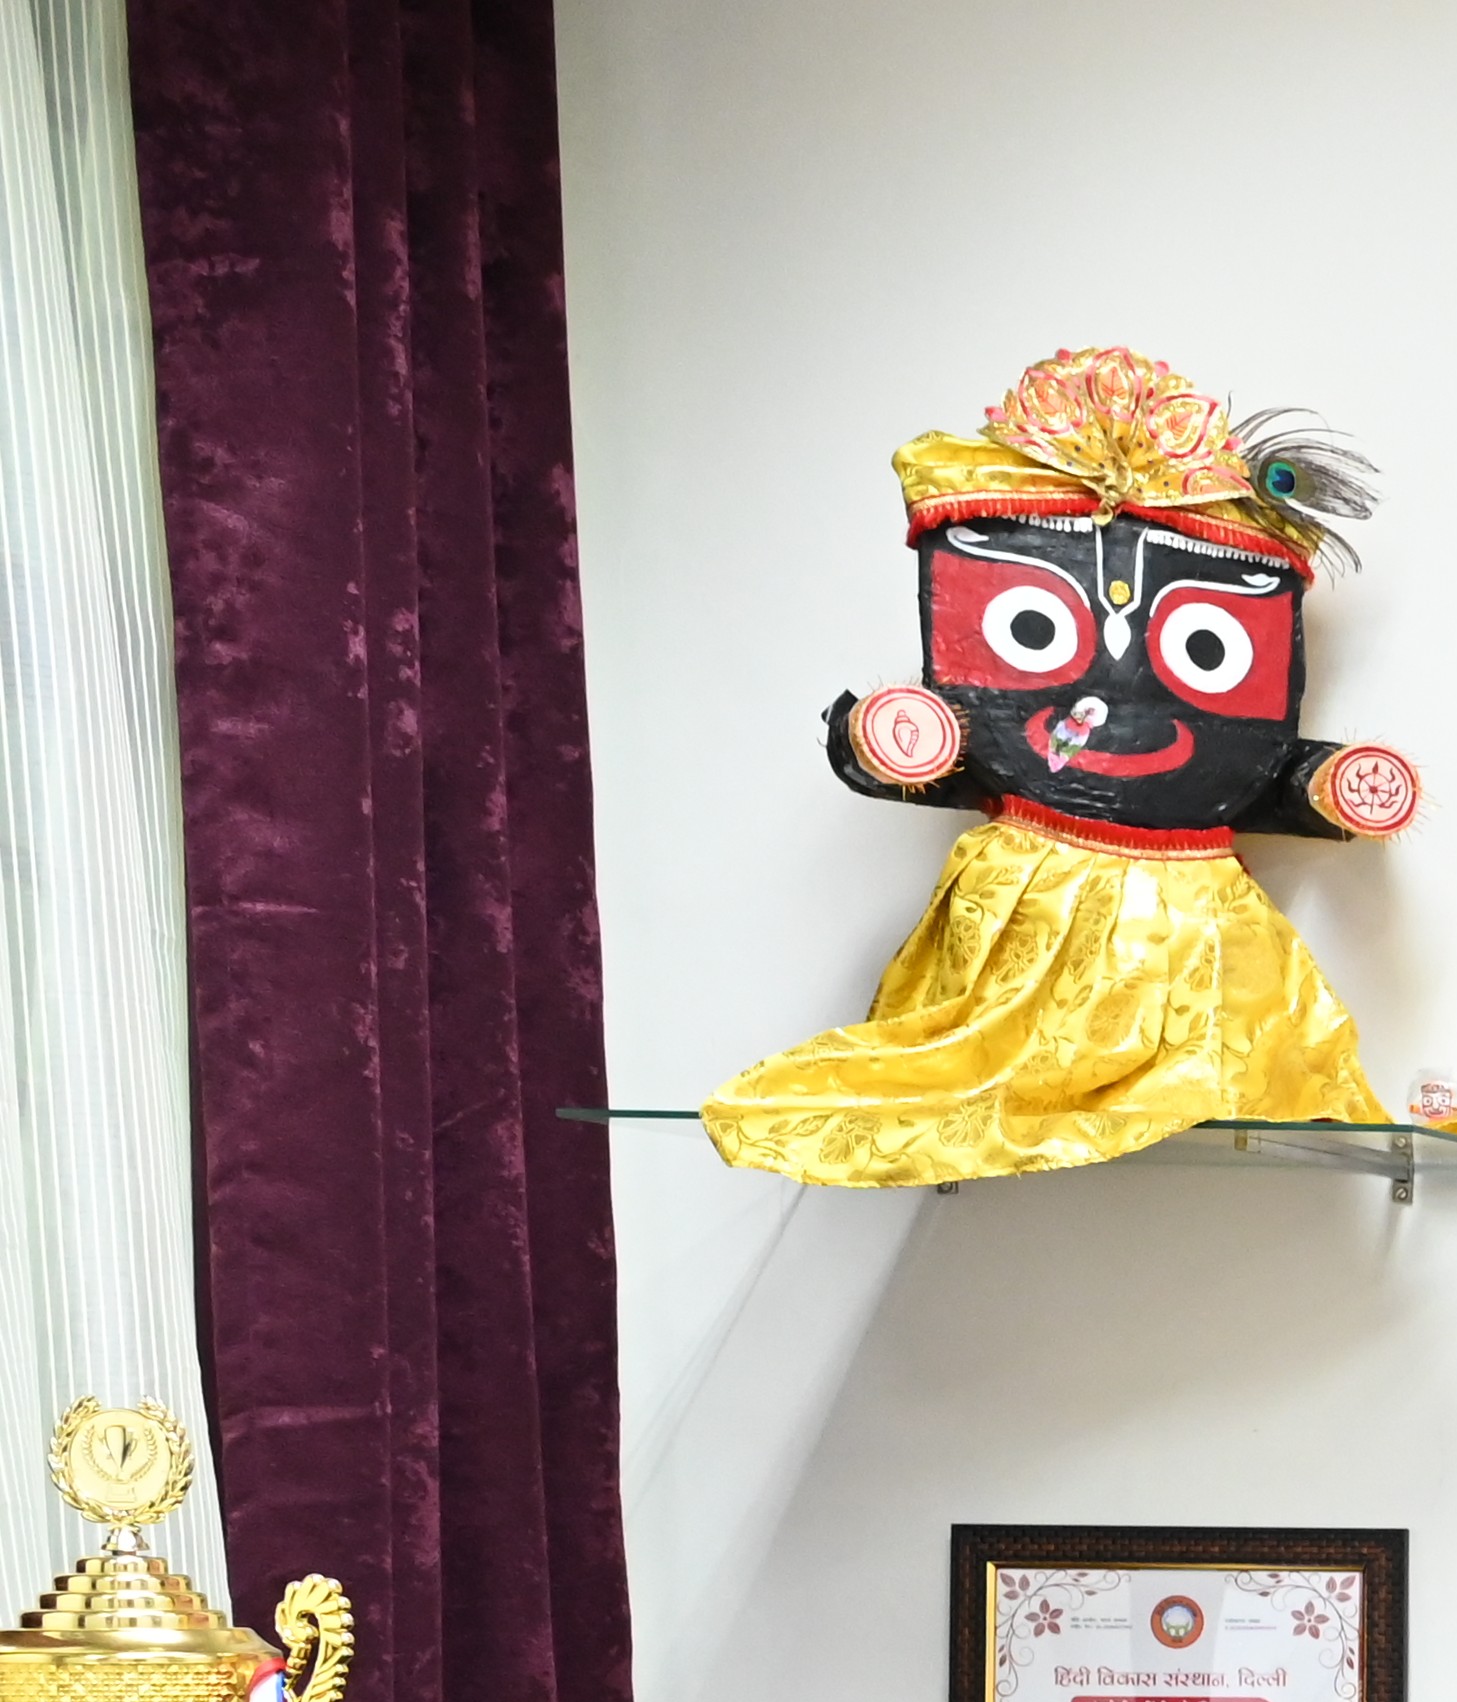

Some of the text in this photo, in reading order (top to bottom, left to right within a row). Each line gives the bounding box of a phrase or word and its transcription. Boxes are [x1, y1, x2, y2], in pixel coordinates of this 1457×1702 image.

[1054, 1666, 1091, 1688] हिंदी
[1097, 1666, 1158, 1688] विकास
[1238, 1666, 1288, 1688] दिल्ली
